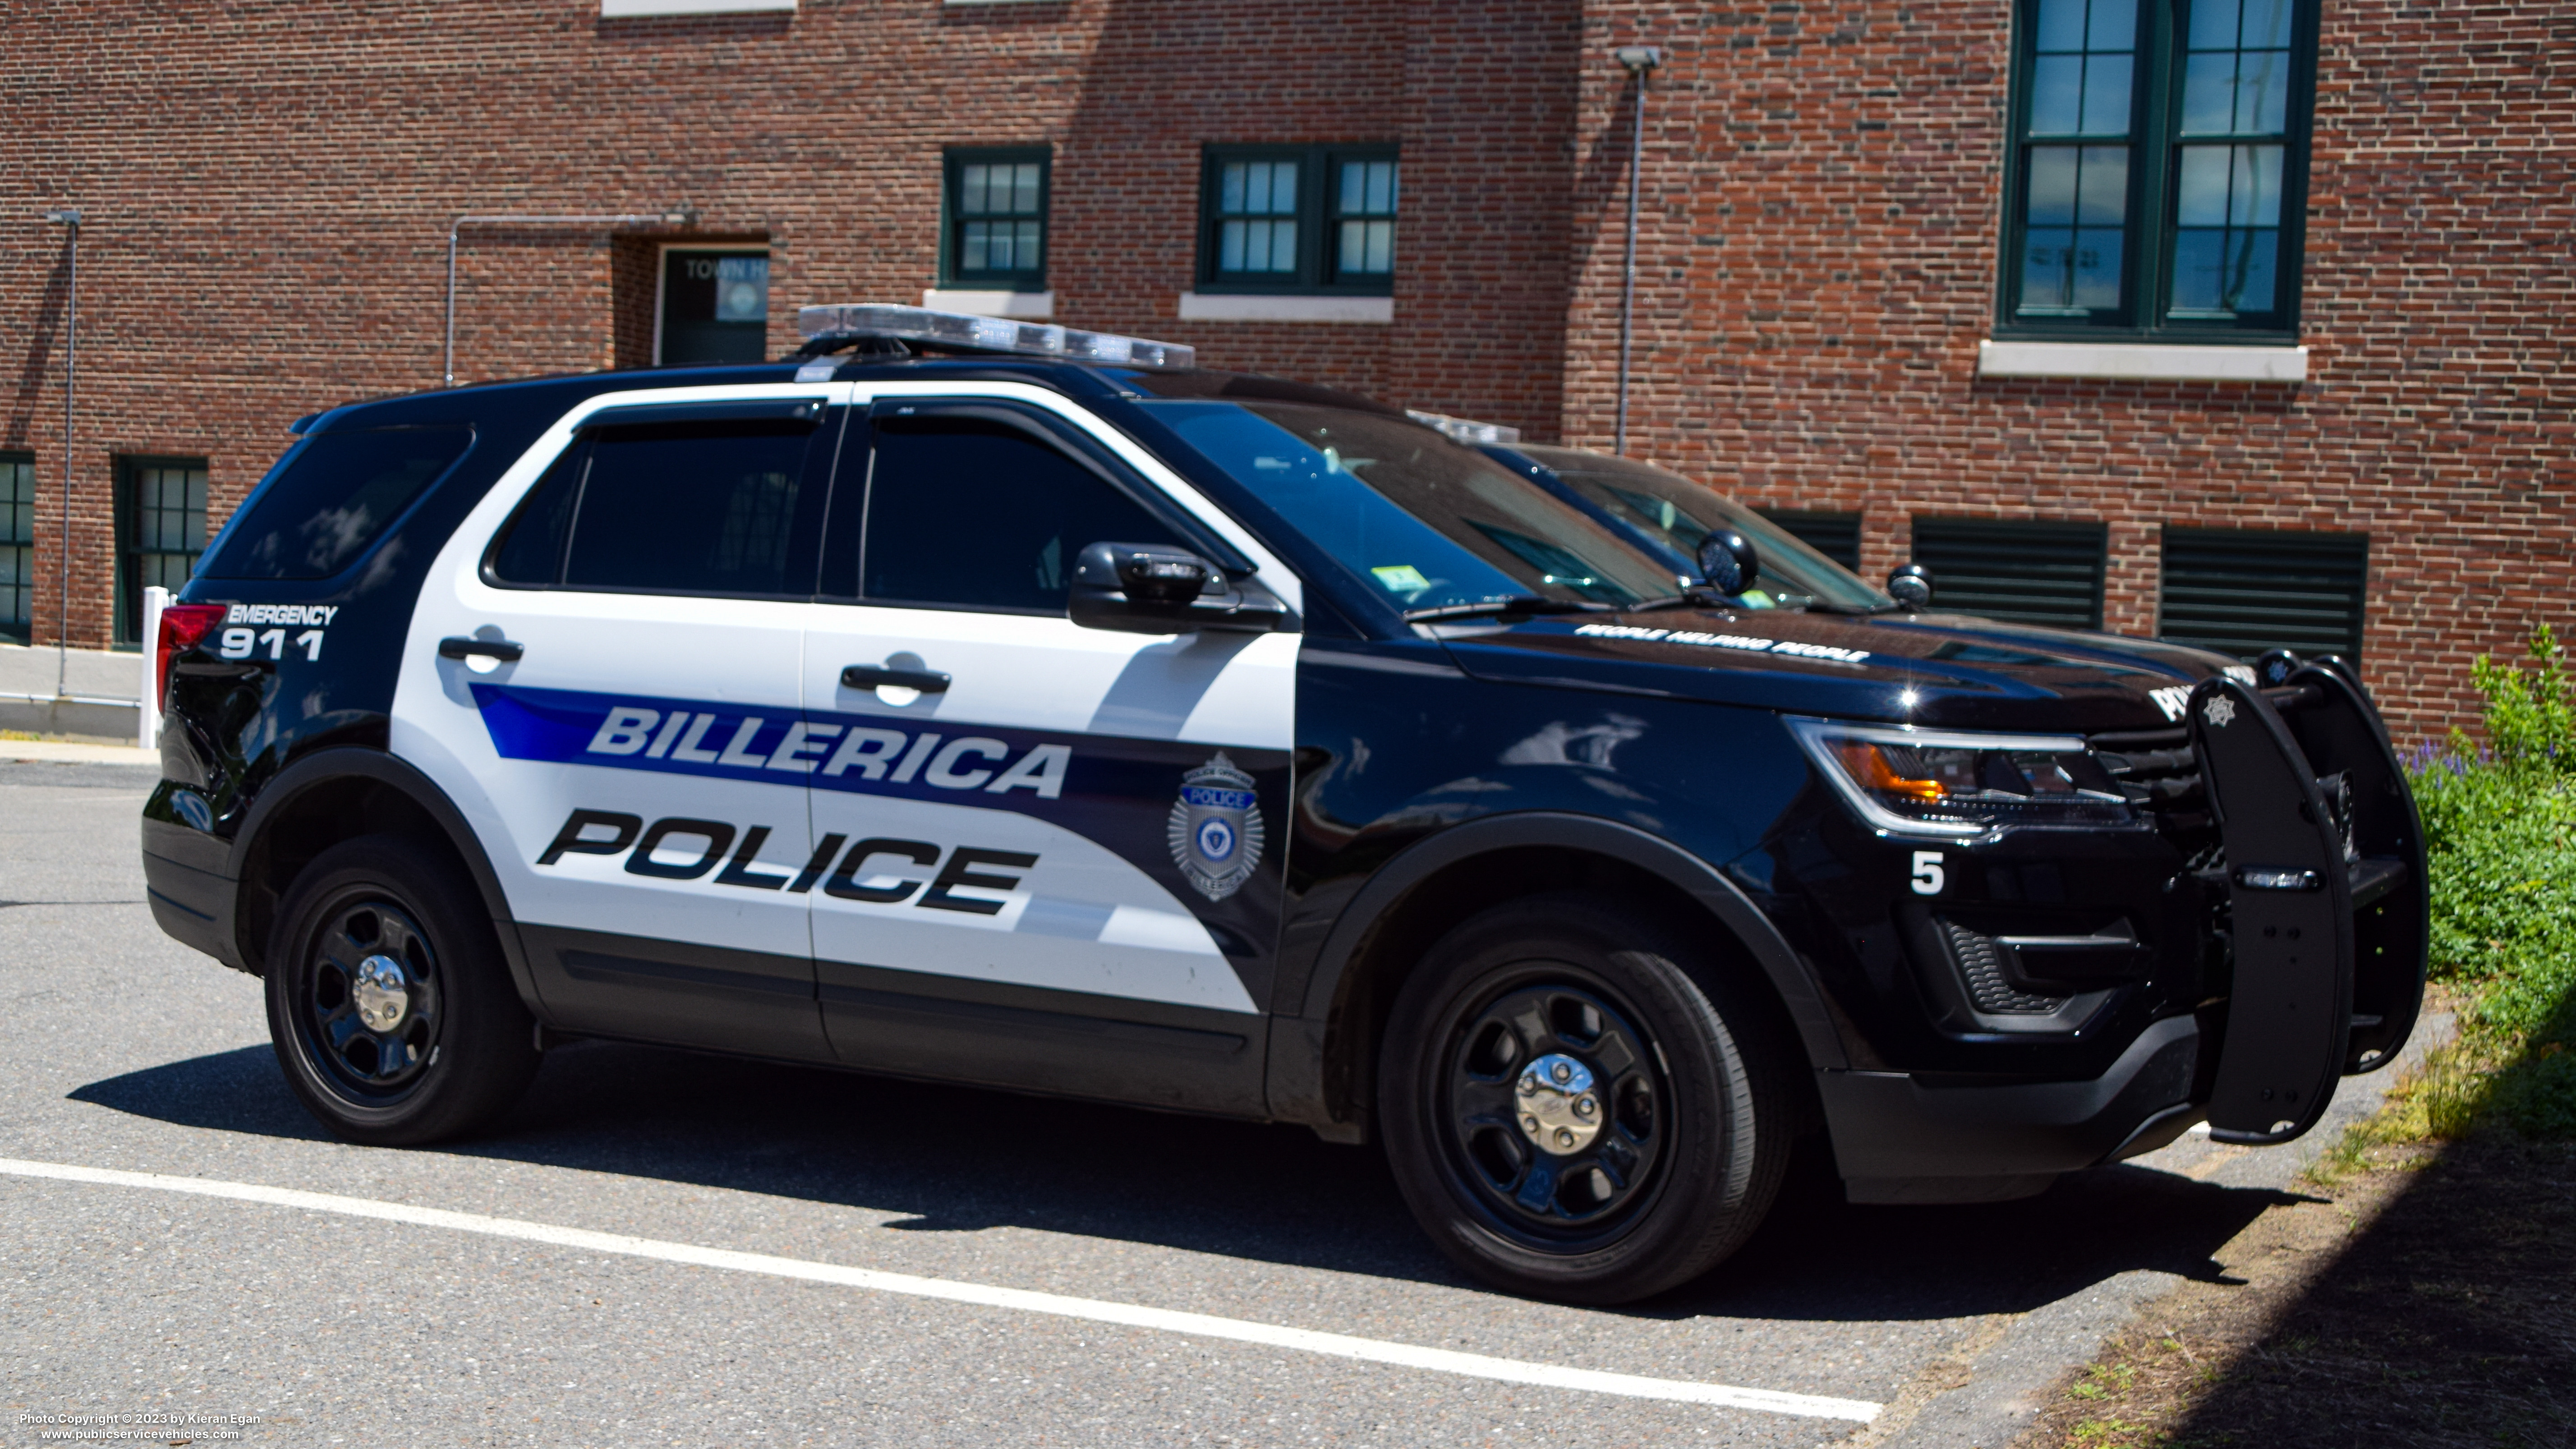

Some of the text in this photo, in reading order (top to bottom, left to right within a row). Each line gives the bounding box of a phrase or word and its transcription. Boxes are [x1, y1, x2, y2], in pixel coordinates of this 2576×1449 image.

[685, 259, 745, 281] TOWN
[228, 604, 338, 626] EMERGENCY
[221, 628, 324, 661] 911
[1574, 624, 1870, 663] PEOPLE HELPING PEOPLE
[587, 706, 1072, 799] BILLERICA
[1191, 789, 1245, 808] POLICE
[536, 808, 1040, 915] POLICE
[1911, 851, 1944, 894] 5
